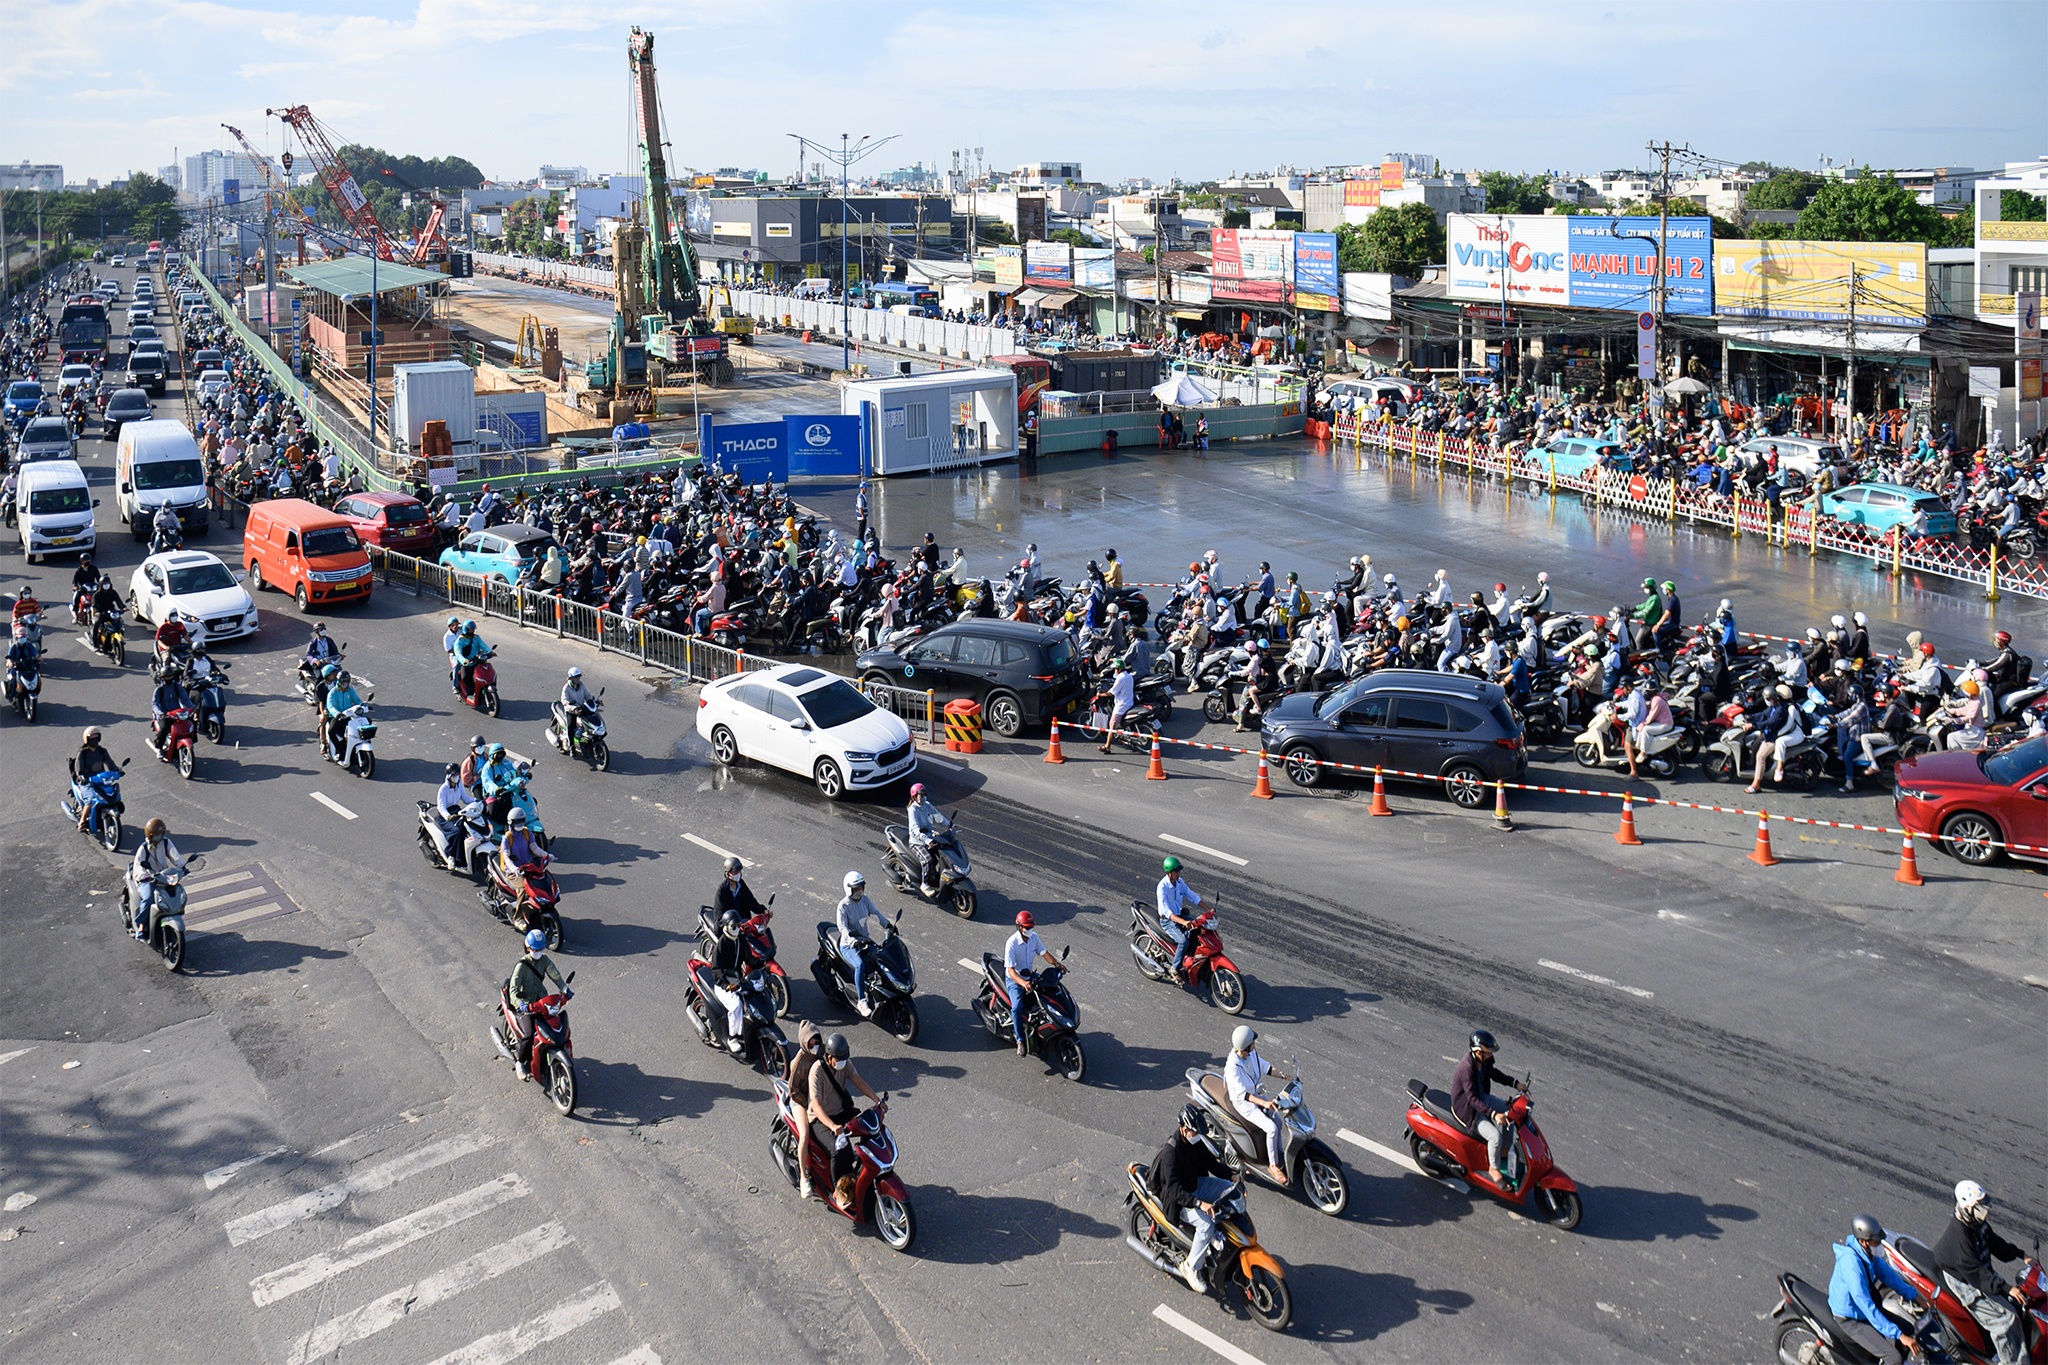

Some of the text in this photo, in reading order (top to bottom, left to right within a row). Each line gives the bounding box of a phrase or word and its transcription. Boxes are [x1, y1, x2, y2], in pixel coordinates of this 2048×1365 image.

[1476, 225, 1509, 241] Thép
[1215, 261, 1239, 275] MINH
[1571, 253, 1704, 279] MẠNH LIH 2
[722, 437, 778, 453] THACO
